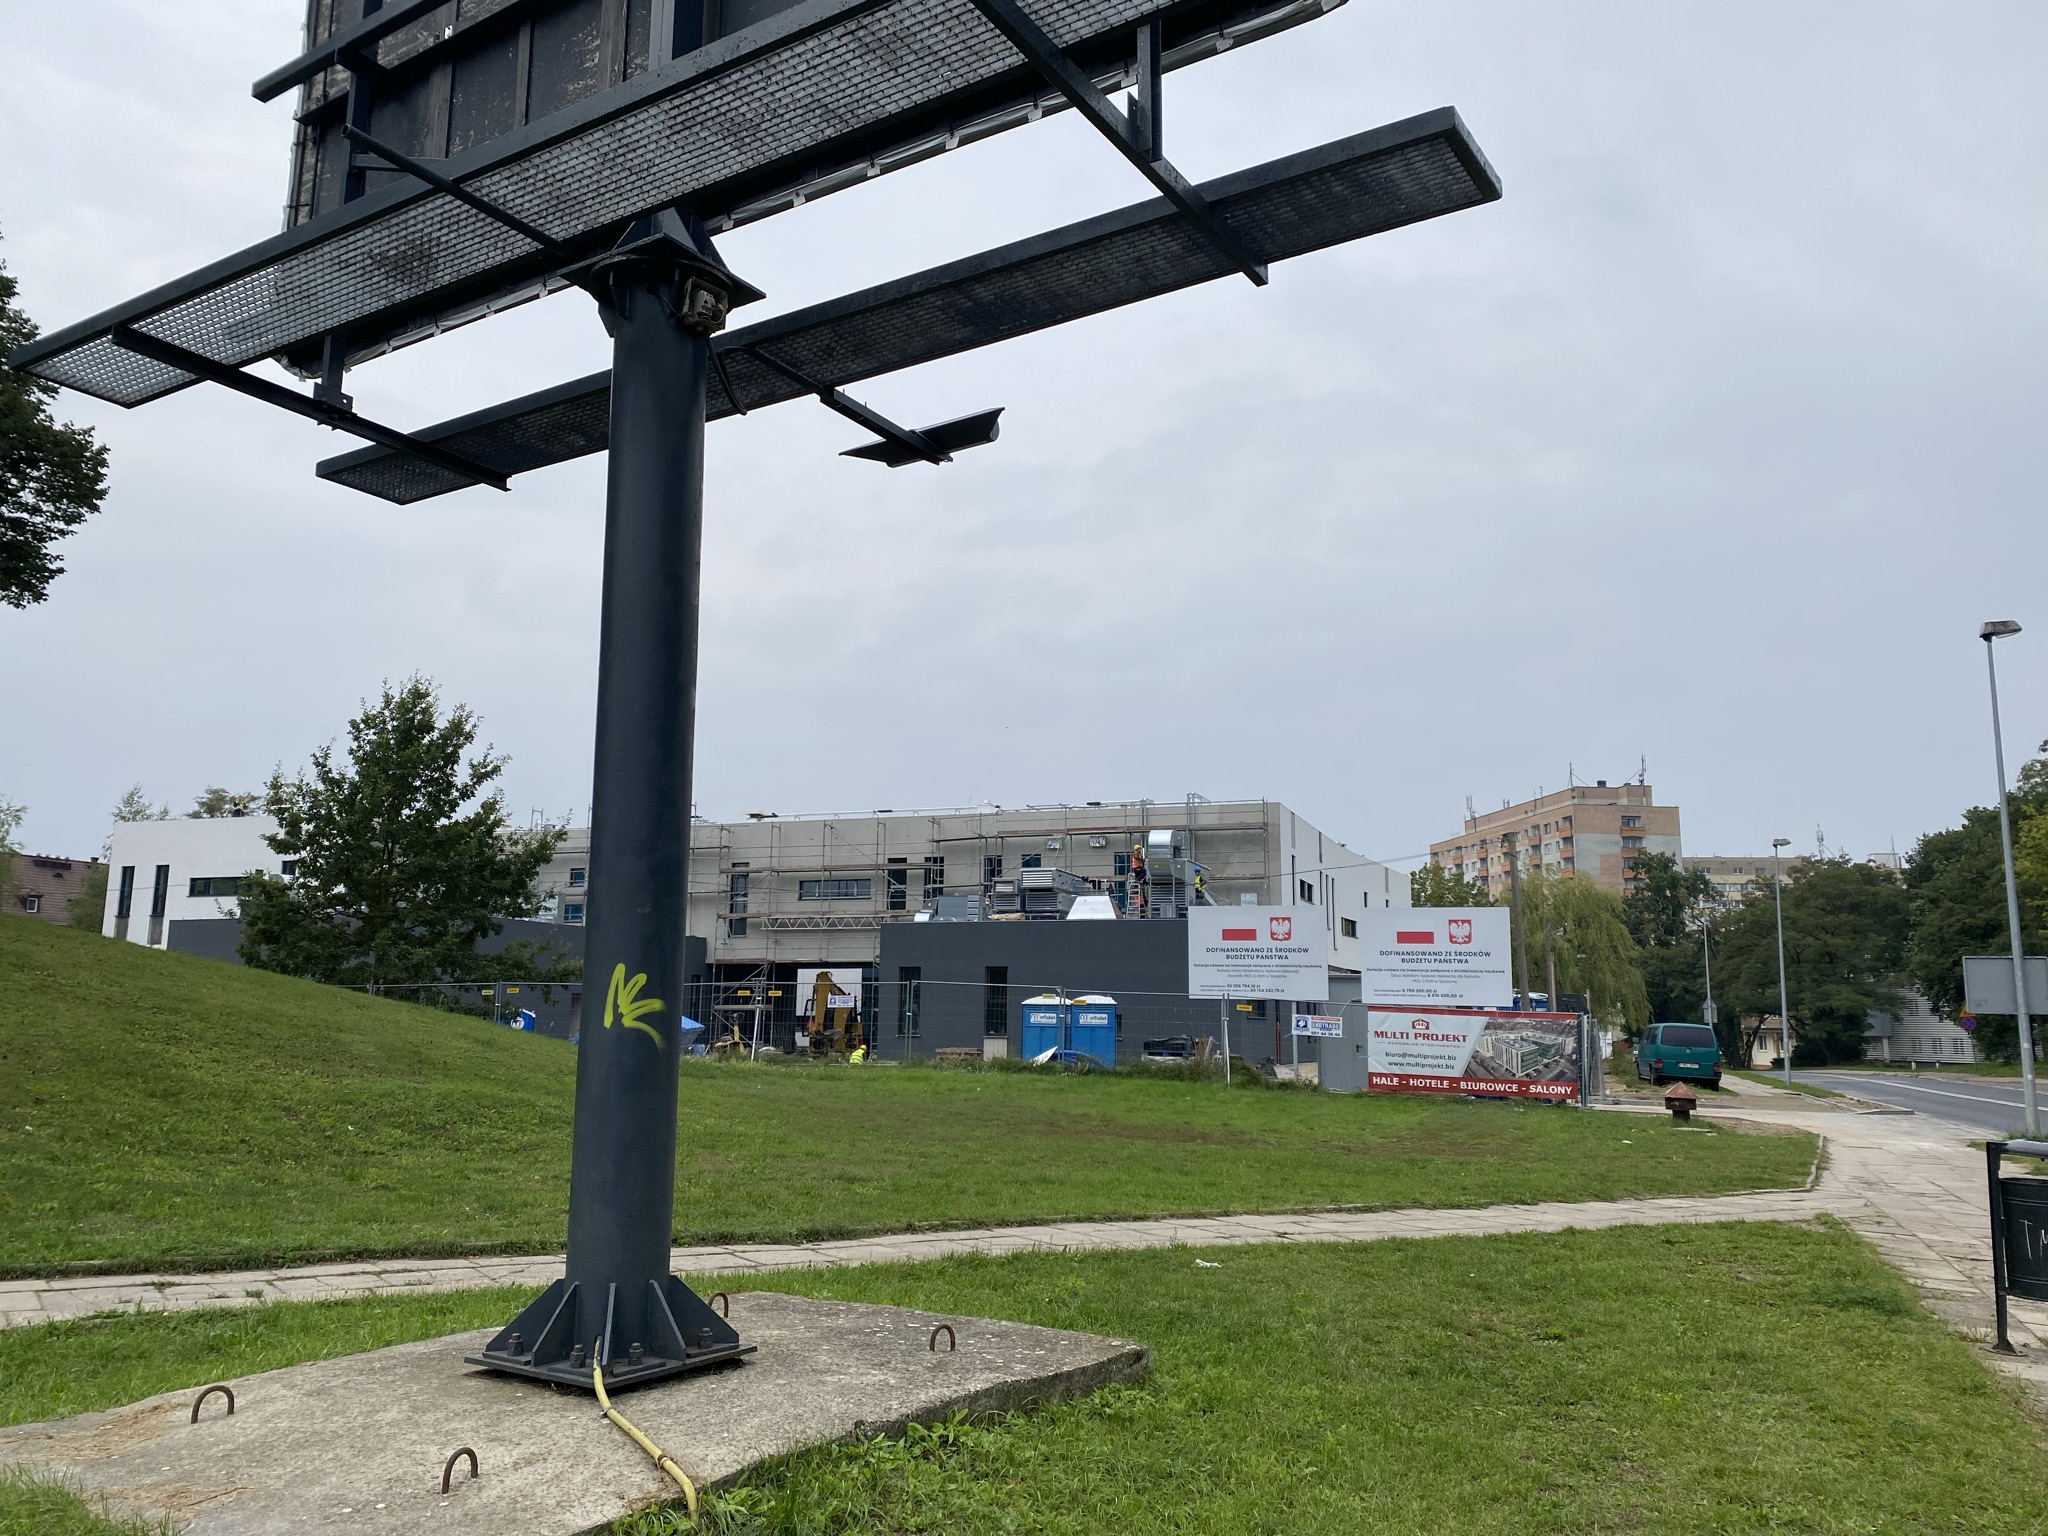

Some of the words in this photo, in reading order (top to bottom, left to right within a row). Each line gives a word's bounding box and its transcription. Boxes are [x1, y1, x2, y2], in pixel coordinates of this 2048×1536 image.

[1374, 1030, 1409, 1040] MULTI
[1414, 1032, 1468, 1042] PROJEKT
[1386, 1052, 1456, 1061] biuro@multiprojekt.biz
[1388, 1061, 1454, 1070] www.multiprojekt.biz
[1372, 1076, 1400, 1085] HALE
[1410, 1078, 1450, 1088] HOTELE
[1460, 1082, 1518, 1092] BIUROWCE
[1529, 1085, 1572, 1094] SALONY
